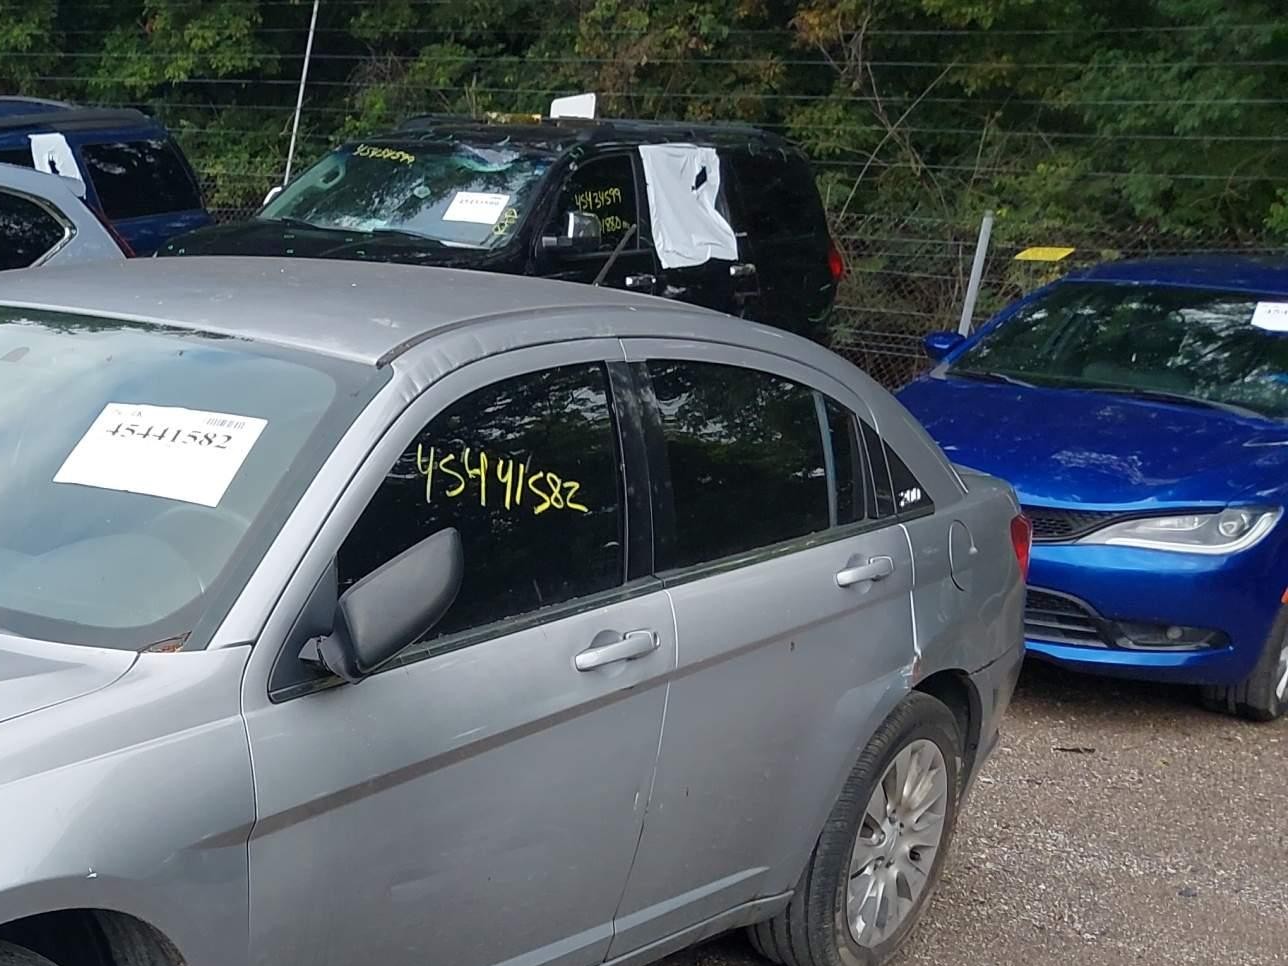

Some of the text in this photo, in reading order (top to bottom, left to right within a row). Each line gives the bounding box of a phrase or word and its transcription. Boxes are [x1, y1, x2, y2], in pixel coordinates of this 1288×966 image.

[575, 187, 622, 212] 45434599
[106, 423, 232, 449] 45441582
[417, 443, 589, 515] 45441582
